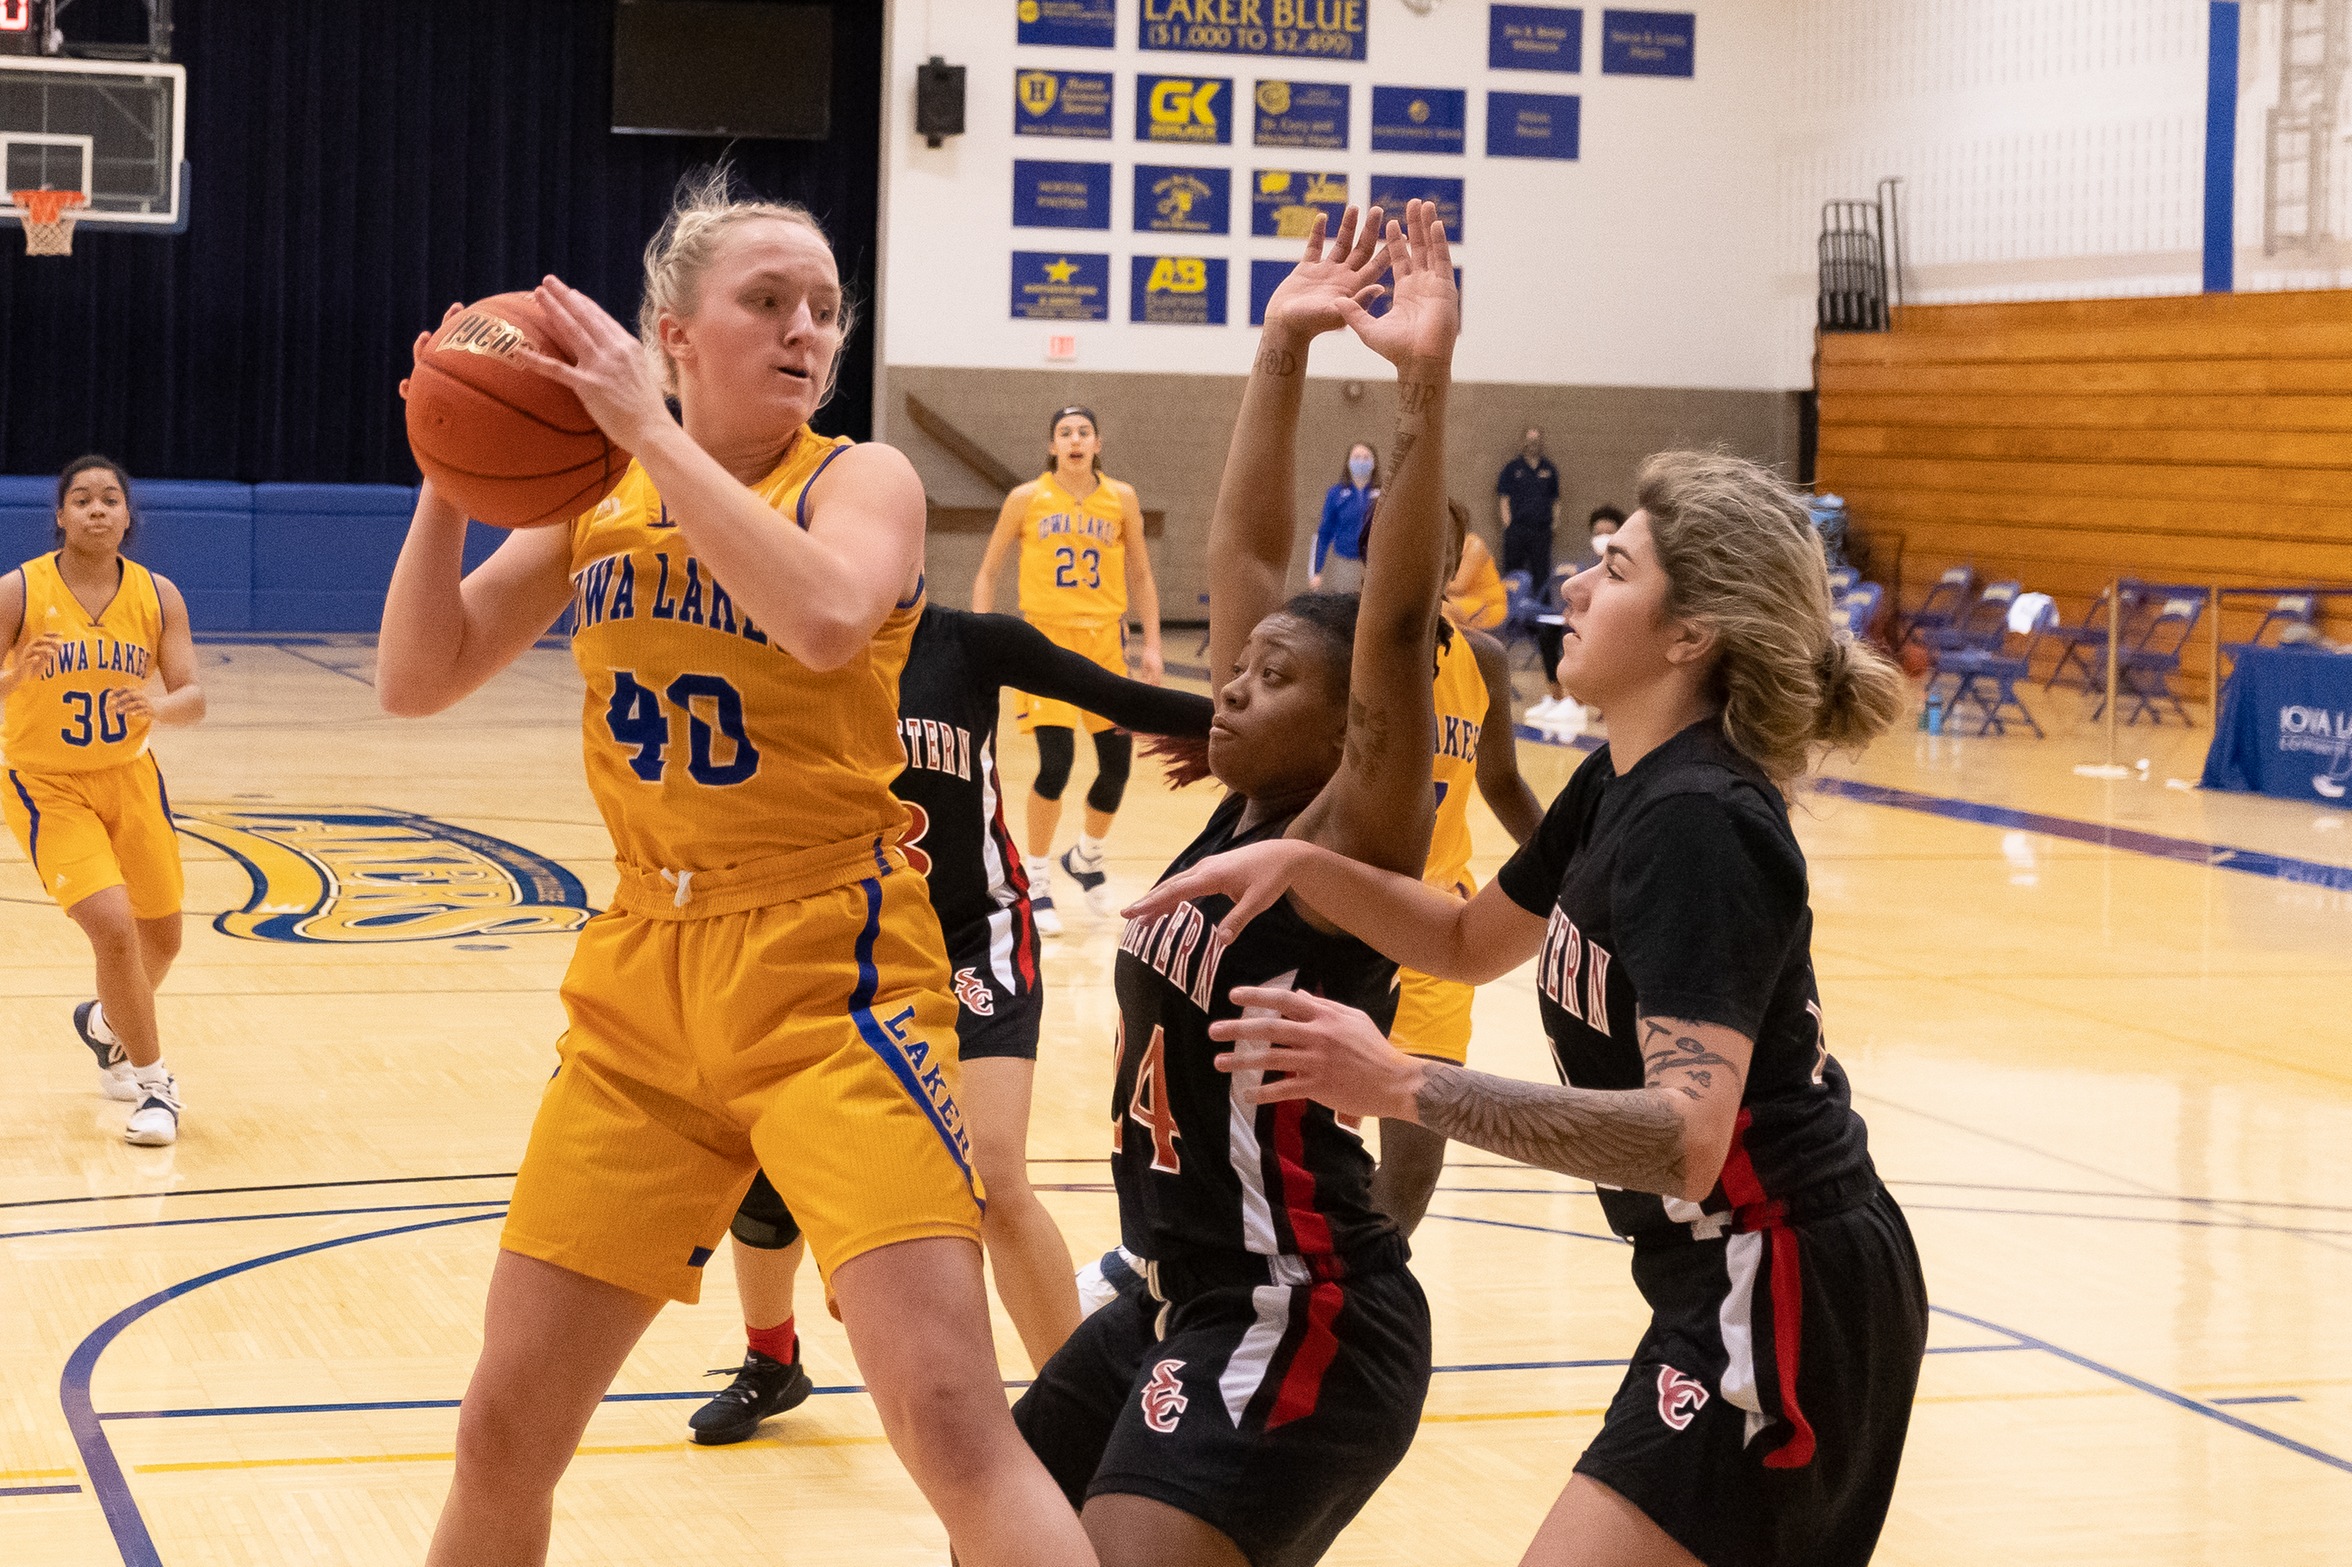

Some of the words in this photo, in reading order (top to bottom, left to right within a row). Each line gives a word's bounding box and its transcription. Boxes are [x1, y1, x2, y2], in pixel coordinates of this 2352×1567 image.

[1144, 0, 1263, 26] LAKER
[1271, 0, 1363, 32] BLUE
[1237, 28, 1267, 50] TO
[1150, 81, 1222, 125] GK
[442, 313, 534, 358] NJCA
[1056, 547, 1100, 589] 23
[652, 552, 789, 654] LAK
[41, 640, 89, 681] OWA
[60, 688, 128, 747] 30
[605, 667, 761, 786] 40
[1113, 1008, 1181, 1175] 4
